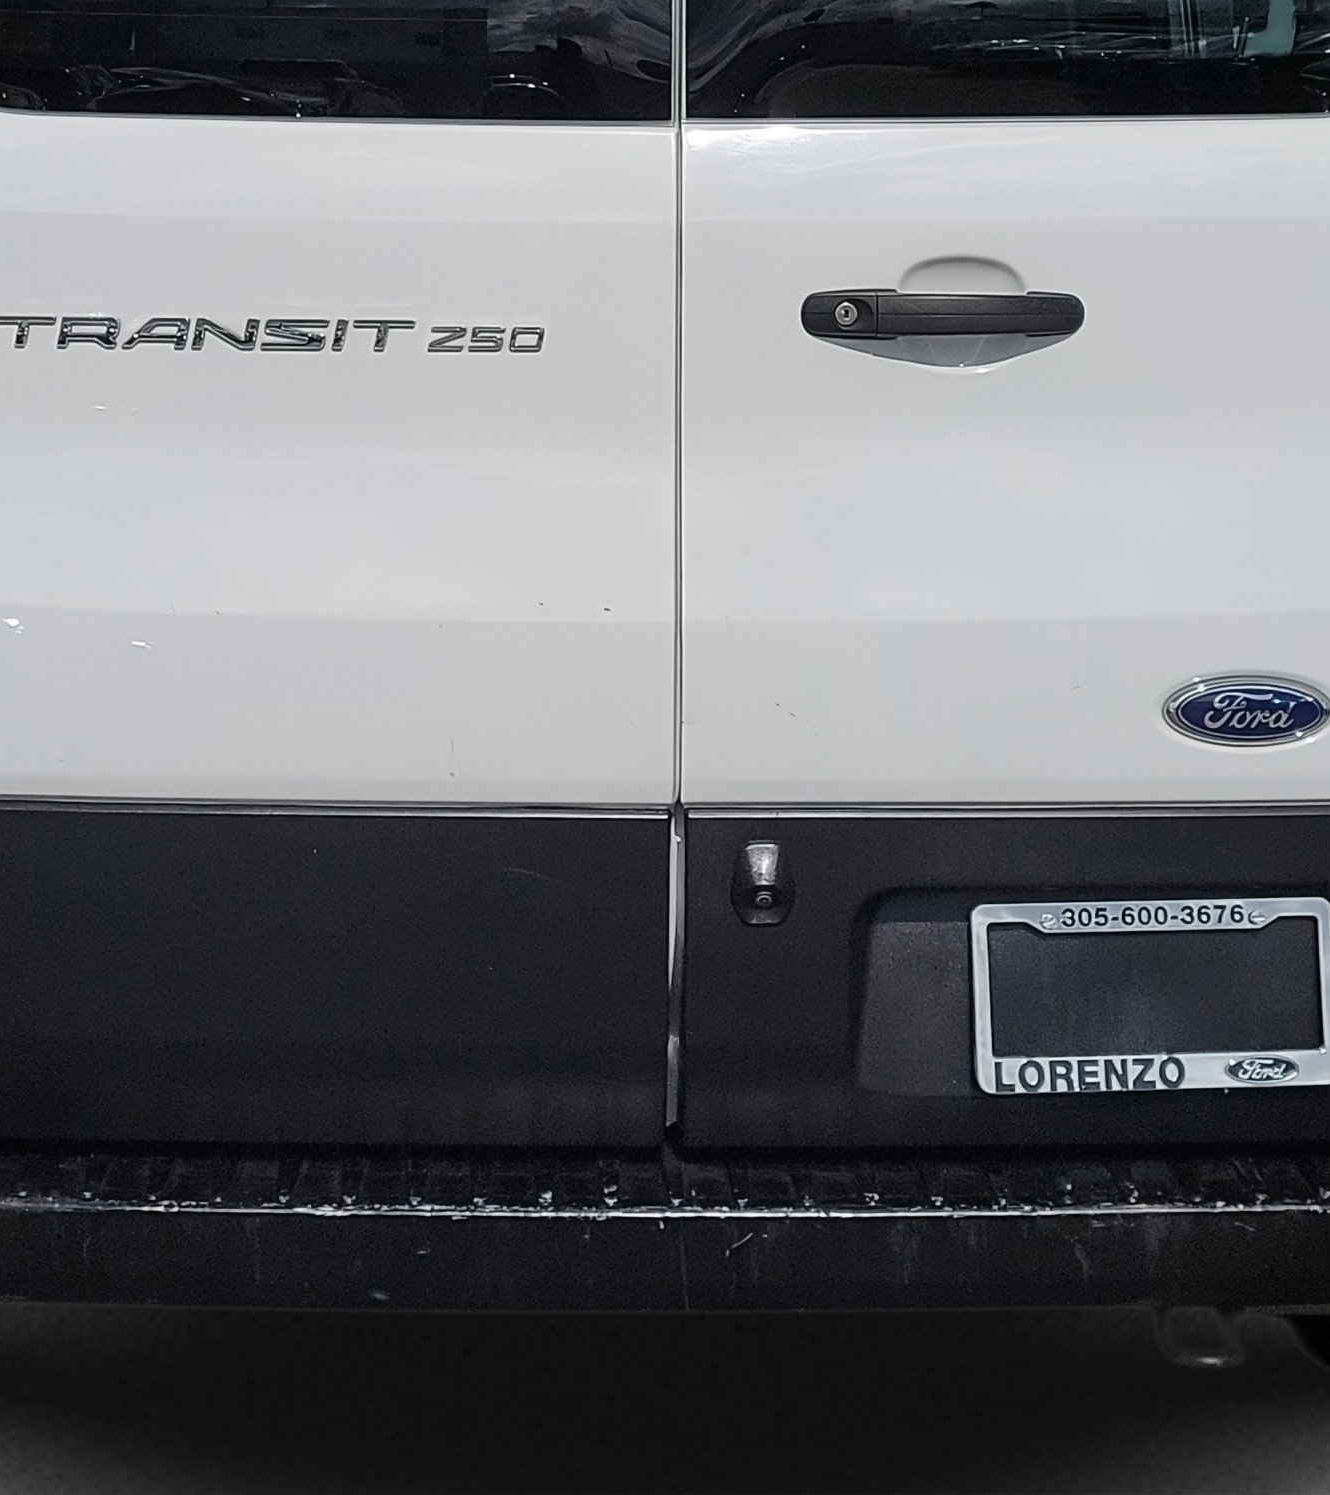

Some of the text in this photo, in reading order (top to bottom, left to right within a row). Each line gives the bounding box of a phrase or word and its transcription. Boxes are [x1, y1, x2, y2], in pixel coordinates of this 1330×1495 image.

[426, 326, 545, 353] 250
[1204, 692, 1295, 729] Ford
[1061, 905, 1245, 928] 305-600-3676
[994, 1056, 1289, 1094] LORENZO Ford
